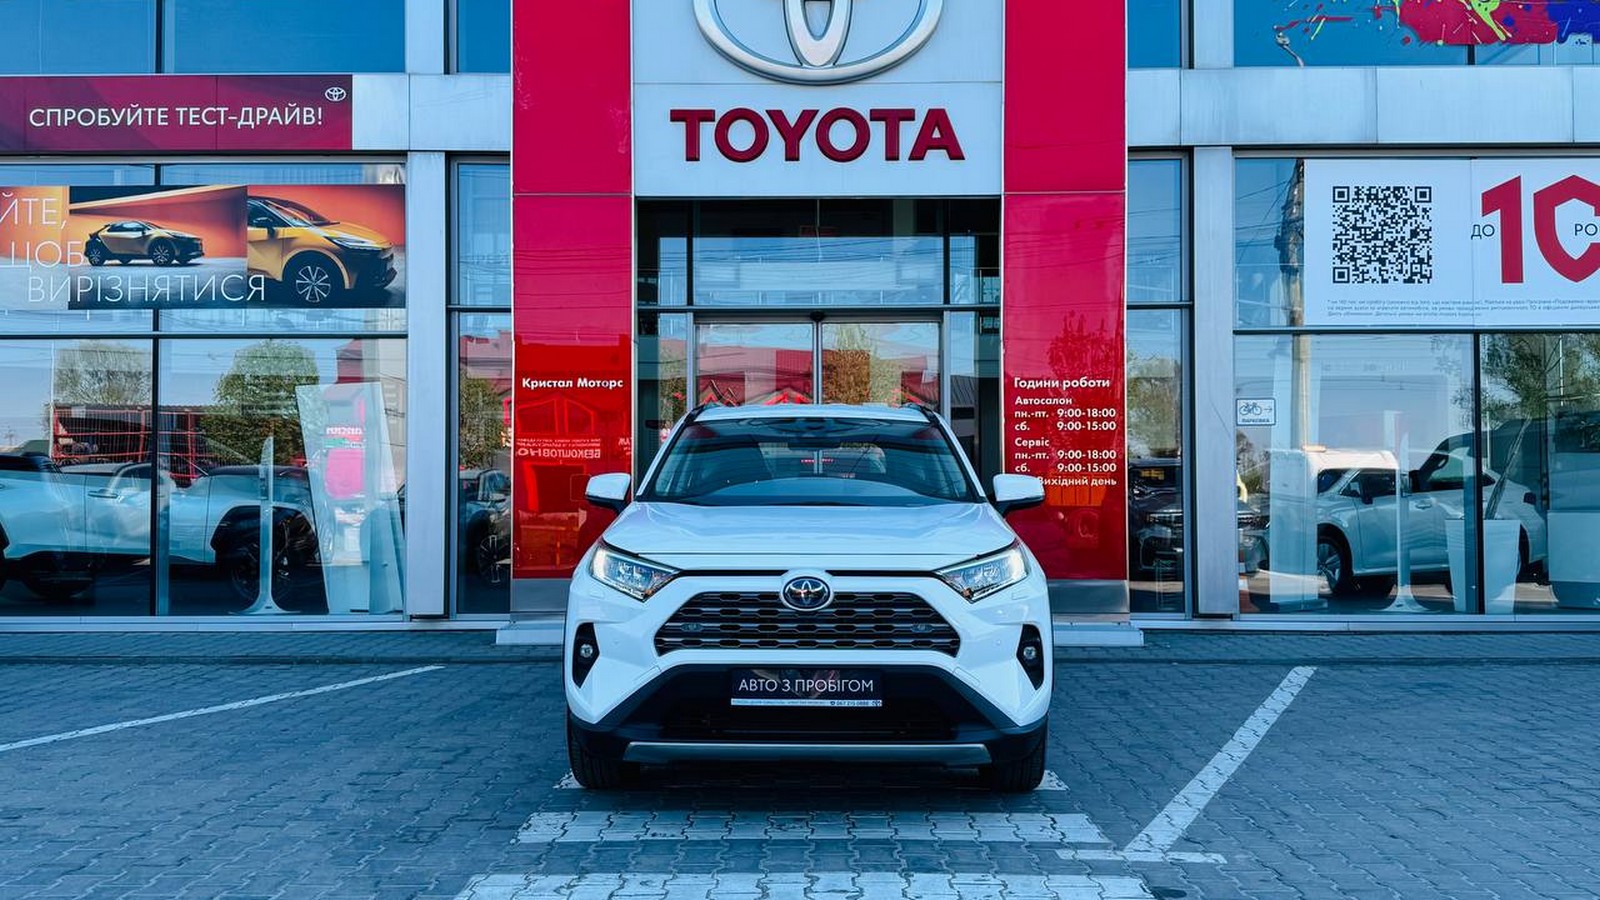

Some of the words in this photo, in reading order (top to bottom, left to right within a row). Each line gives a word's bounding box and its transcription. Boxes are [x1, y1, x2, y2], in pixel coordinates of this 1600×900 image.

[29, 104, 169, 127] СПРОБУЙТЕ
[176, 103, 323, 128] ТЕСТ-ДРАЙВ!
[670, 107, 965, 163] TOYOTA
[1471, 224, 1495, 240] ДО
[28, 275, 265, 303] ВИРІЗНЯТИСЯ
[522, 378, 573, 390] Кристал
[577, 378, 624, 390] Моторс
[1014, 377, 1059, 388] Години
[1062, 376, 1110, 390] роботи
[1015, 396, 1072, 405] Автосалон
[1015, 410, 1049, 418] пн.-пт.
[1057, 408, 1116, 418] 9:00-18:00
[1015, 421, 1030, 431] сб.
[1057, 421, 1116, 430] 9:00-15:00
[1014, 437, 1050, 448] Сервіс
[1015, 451, 1049, 460] пн.-пт.
[1057, 450, 1116, 459] 9:00-18:00
[1015, 463, 1030, 472] сб.
[1057, 463, 1117, 472] 9:00-15:00
[738, 679, 778, 692] АВТО
[782, 679, 791, 692] З
[795, 679, 874, 692] ПРОБІГОМ
